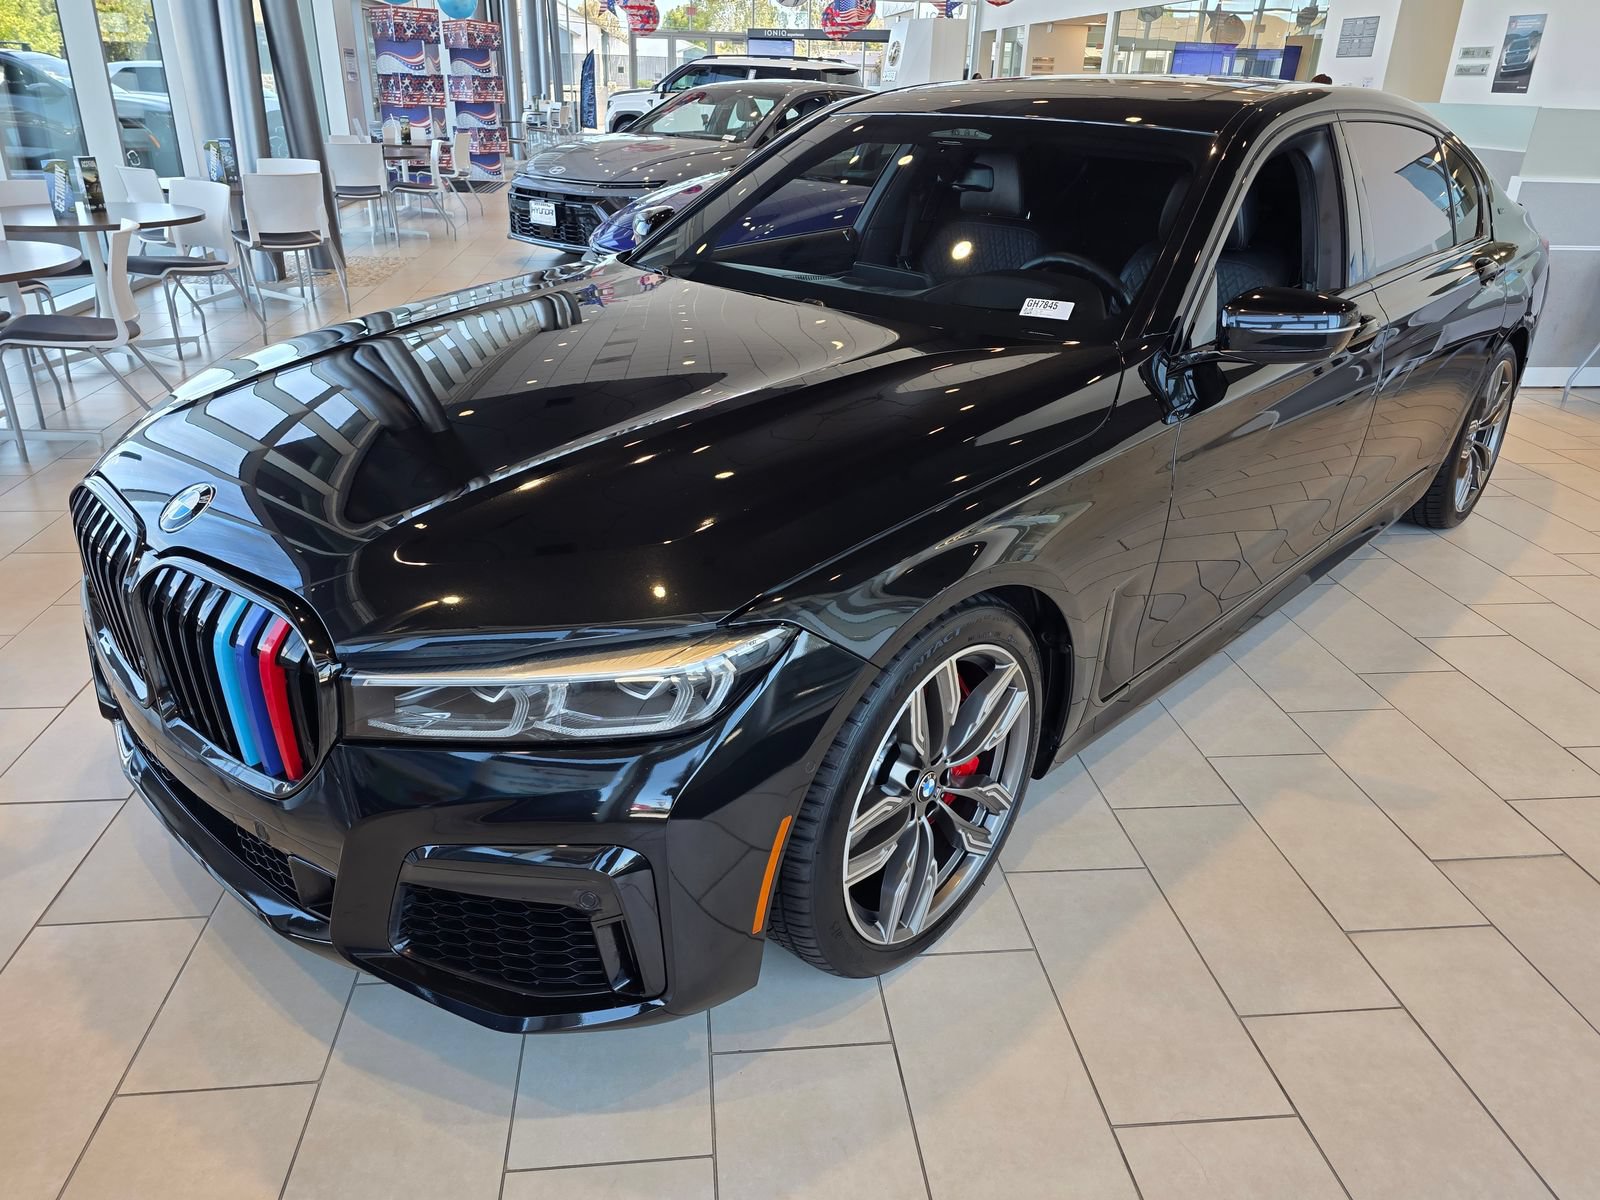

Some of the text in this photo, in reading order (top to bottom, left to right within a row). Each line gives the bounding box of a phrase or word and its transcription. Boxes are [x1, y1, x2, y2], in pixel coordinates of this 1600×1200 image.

[764, 29, 787, 37] IONIQ
[54, 163, 66, 213] GETAWAY
[1026, 299, 1059, 310] GH7845
